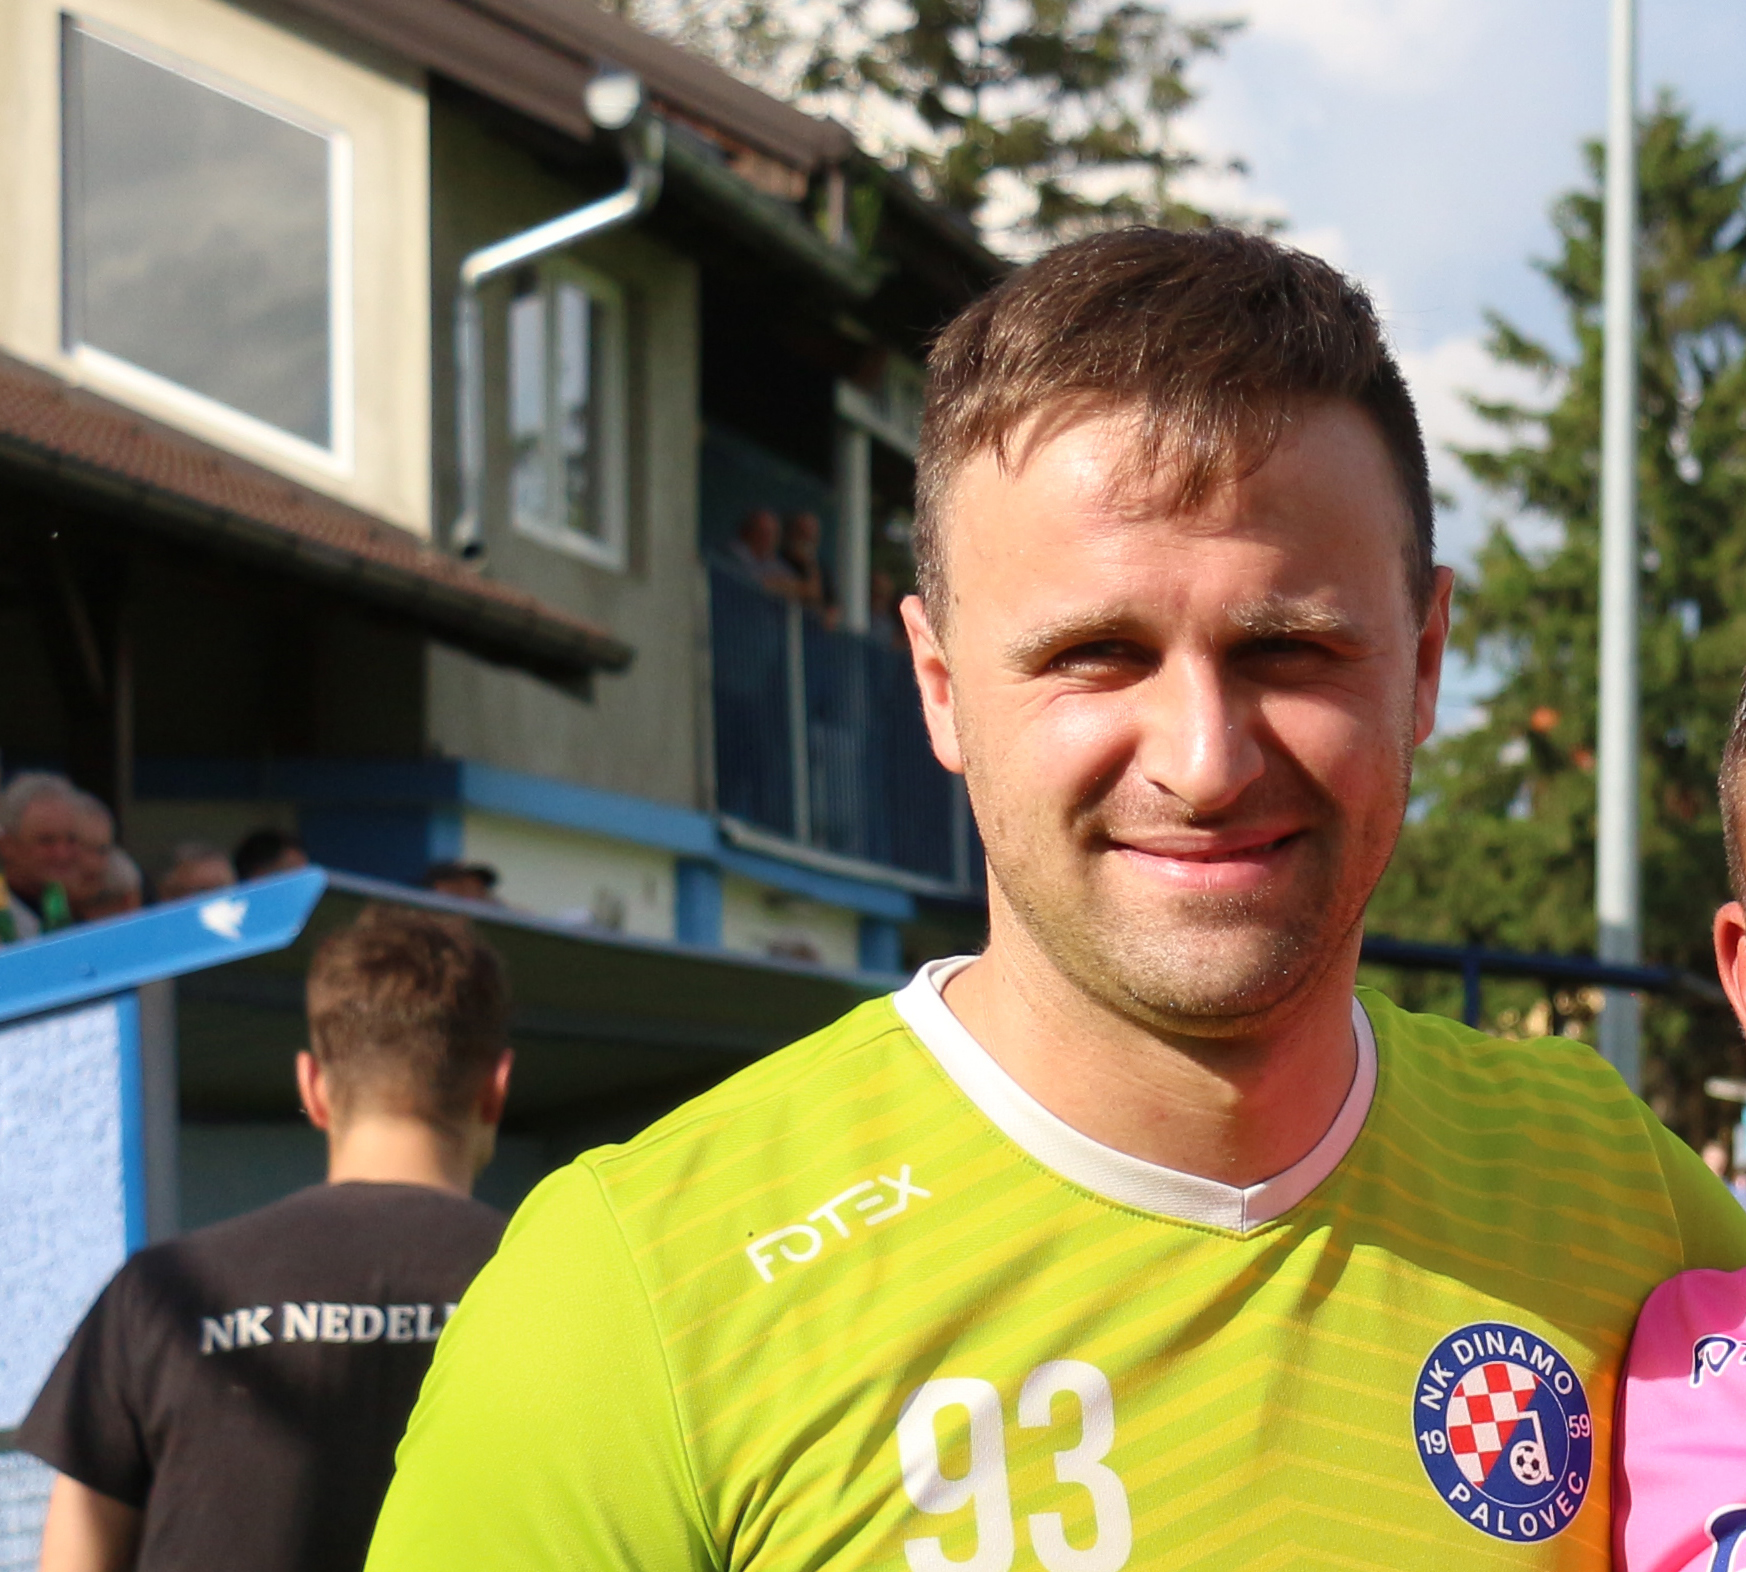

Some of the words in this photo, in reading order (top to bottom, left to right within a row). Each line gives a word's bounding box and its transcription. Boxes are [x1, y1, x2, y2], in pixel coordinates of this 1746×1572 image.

[745, 1164, 932, 1283] FOTEX
[201, 1304, 273, 1356] NK
[1420, 1358, 1455, 1411] NK
[1451, 1330, 1573, 1395] DINAMO
[1419, 1429, 1447, 1455] 19
[1568, 1413, 1591, 1439] 59
[1449, 1471, 1584, 1537] PALOVEC
